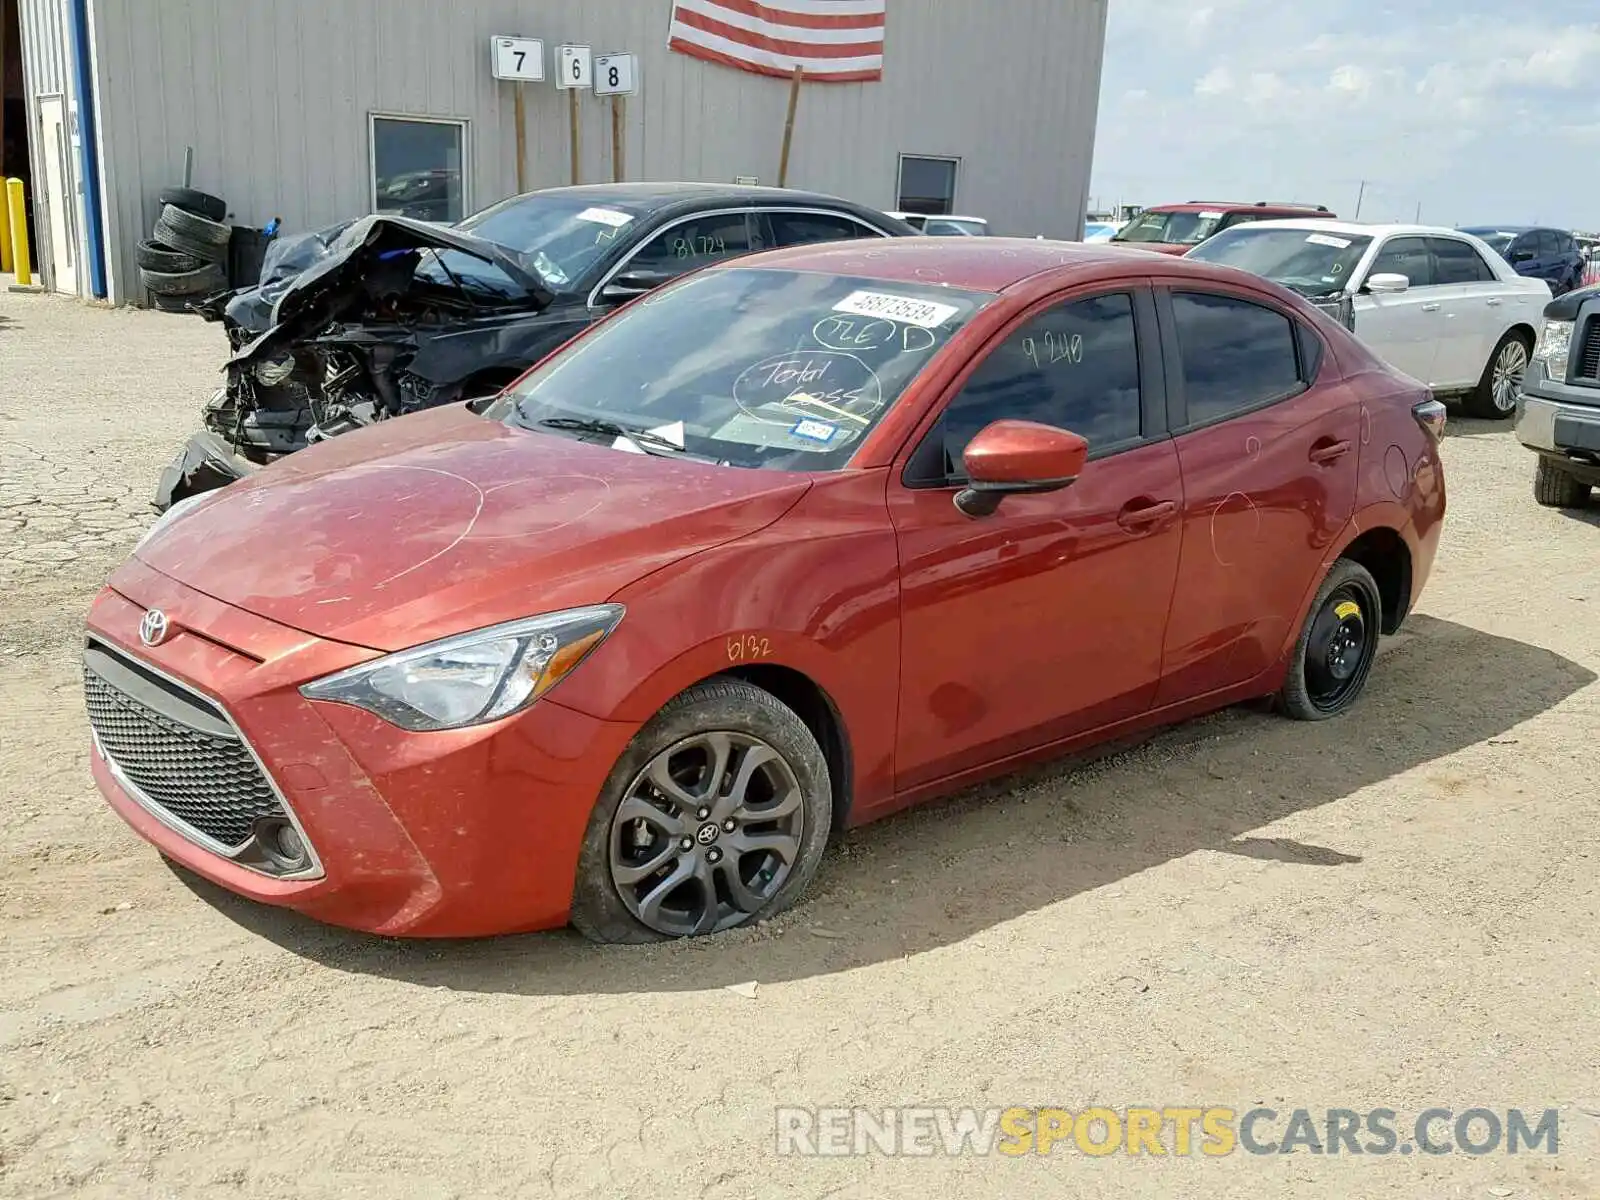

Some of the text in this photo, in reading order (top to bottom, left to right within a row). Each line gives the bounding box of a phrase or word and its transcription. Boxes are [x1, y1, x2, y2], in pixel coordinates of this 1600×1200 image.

[513, 51, 526, 72] 7
[572, 58, 581, 80] 6
[608, 66, 619, 87] 8
[759, 359, 832, 388] Total
